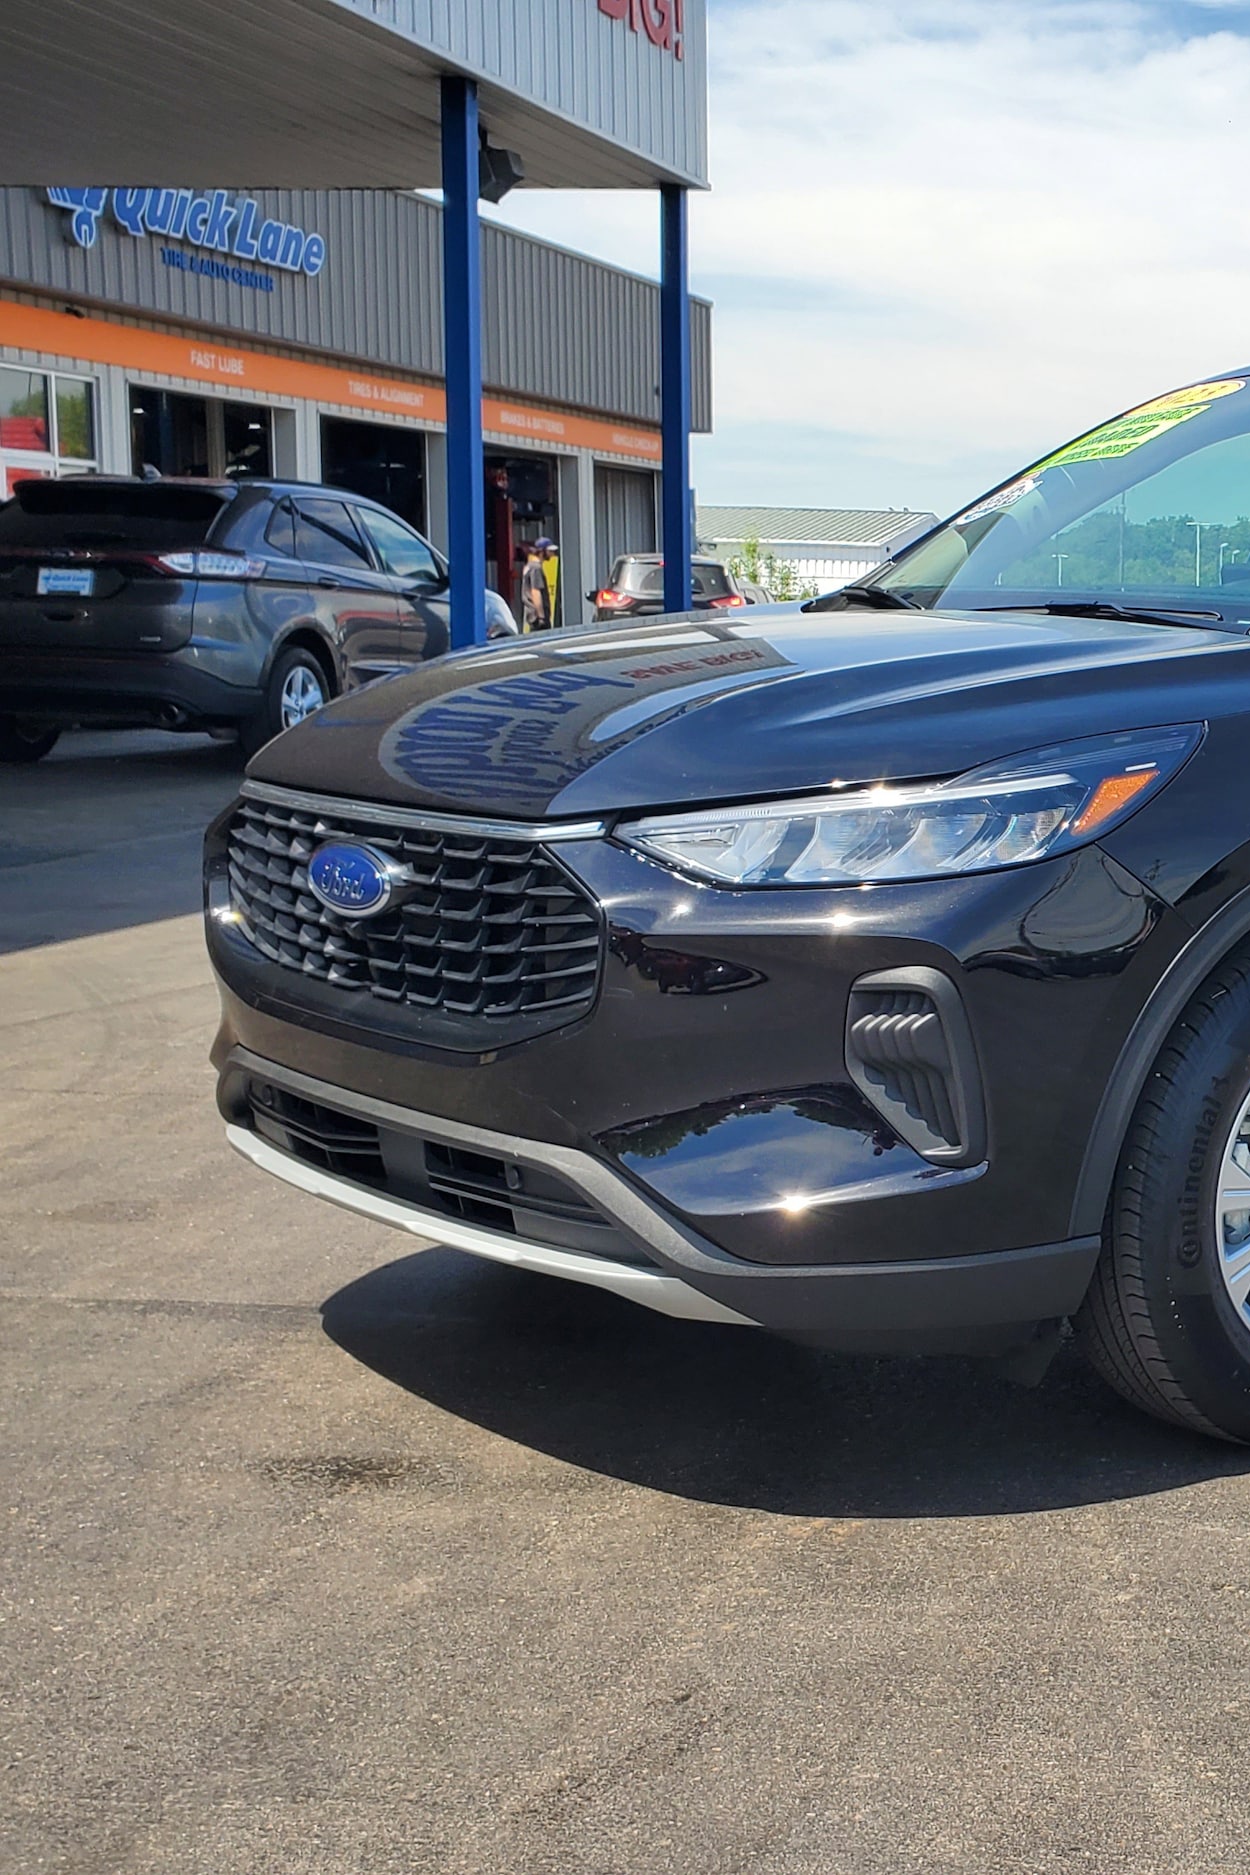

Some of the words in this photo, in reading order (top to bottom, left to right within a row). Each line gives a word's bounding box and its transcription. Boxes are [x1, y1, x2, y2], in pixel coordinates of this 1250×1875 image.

[113, 188, 236, 252] Quick
[234, 198, 325, 277] Lane
[160, 247, 188, 272] TIRE
[200, 259, 230, 282] AUTO
[231, 267, 274, 292] CENTER
[190, 350, 216, 371] FAST
[218, 355, 246, 376] LUBE
[348, 380, 372, 399] TIRES
[320, 859, 367, 900] Ford
[1177, 1095, 1223, 1270] Continental
